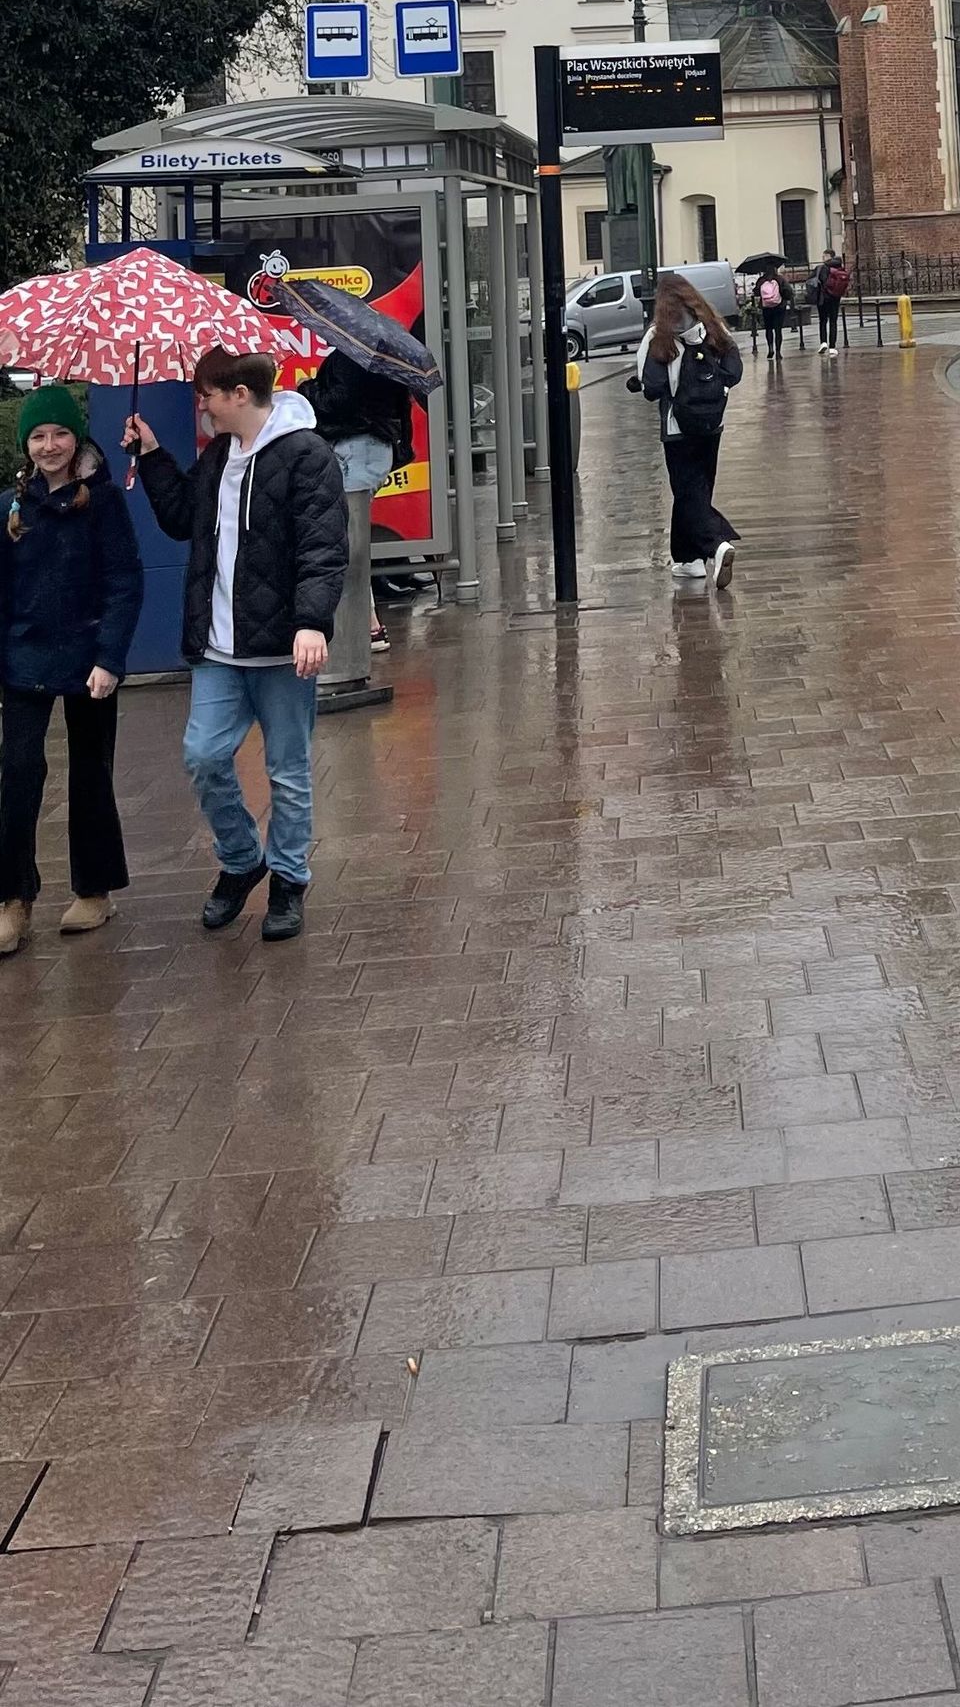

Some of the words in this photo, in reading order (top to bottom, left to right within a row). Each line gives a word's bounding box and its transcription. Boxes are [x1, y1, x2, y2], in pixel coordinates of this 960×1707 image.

[567, 60, 589, 71] Plac
[590, 57, 647, 73] Wszystkich
[141, 152, 282, 170] Bilety-Tickets
